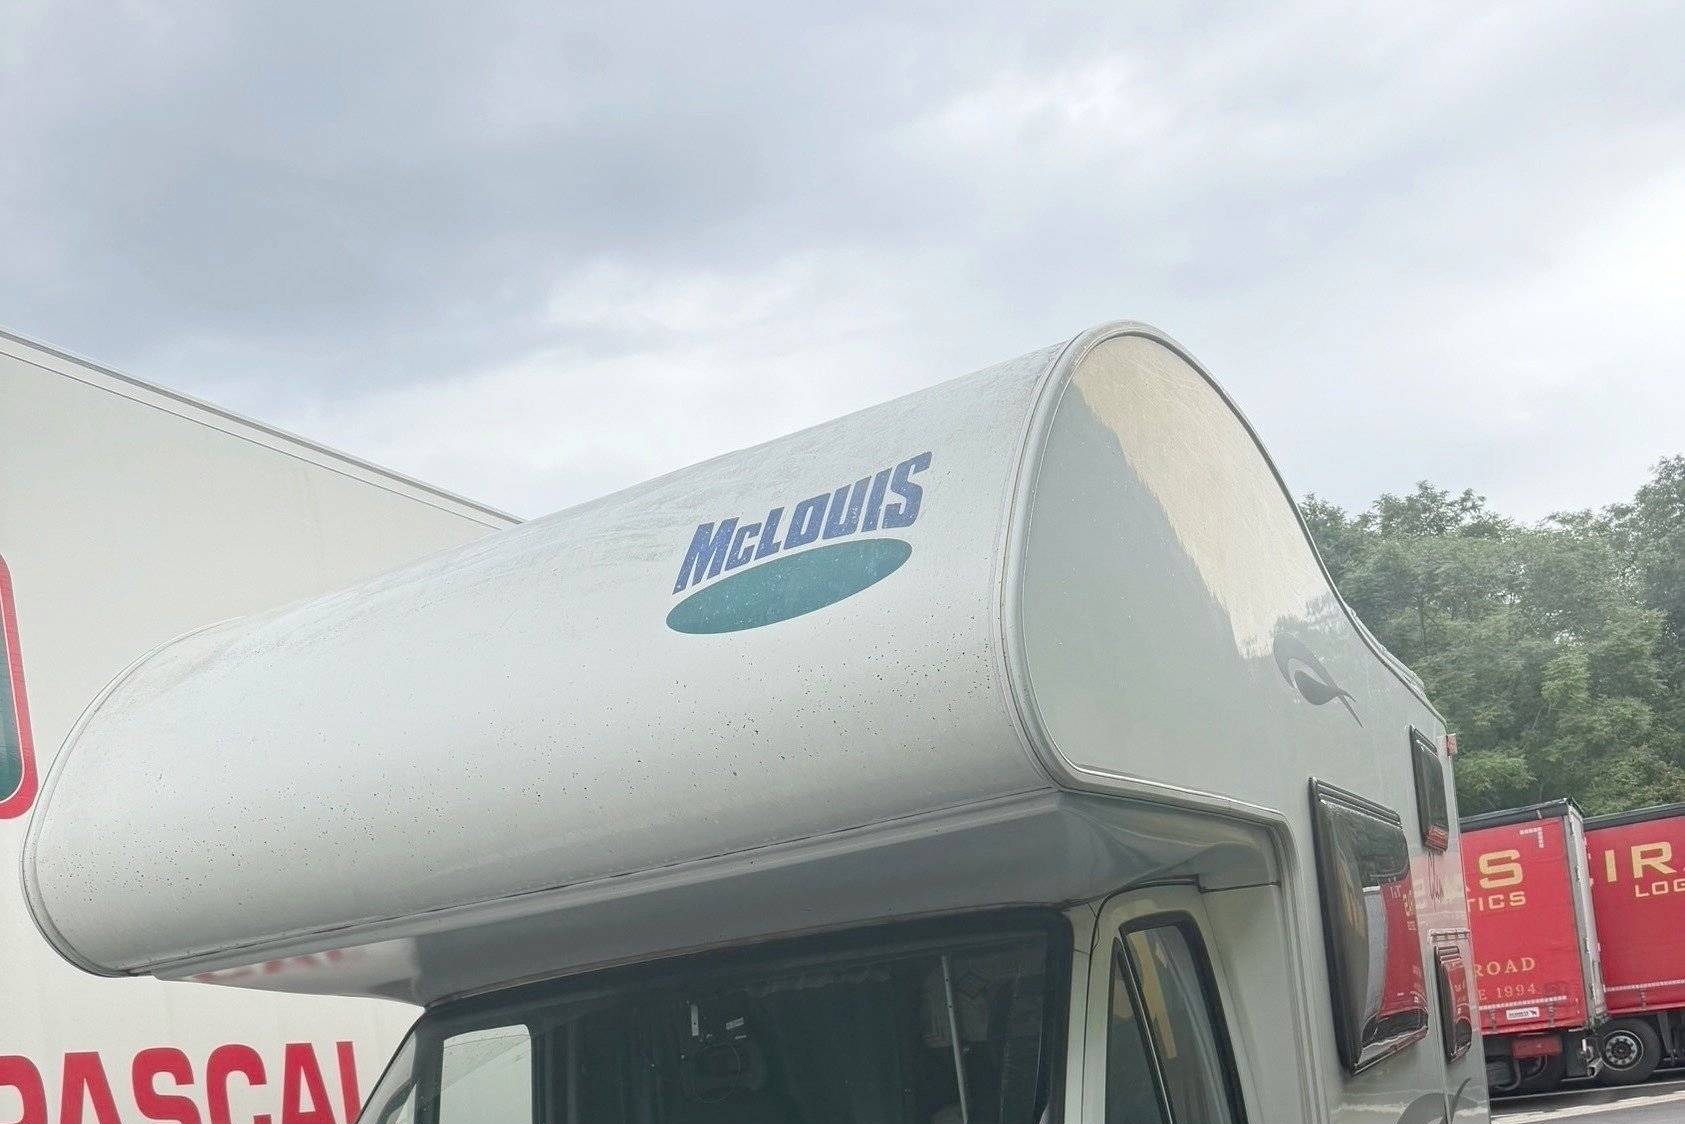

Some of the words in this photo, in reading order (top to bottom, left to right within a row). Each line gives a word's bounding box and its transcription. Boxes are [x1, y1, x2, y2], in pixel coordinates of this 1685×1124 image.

[672, 451, 933, 596] McLOUIS
[1466, 849, 1524, 891] S
[1604, 841, 1685, 883] IR
